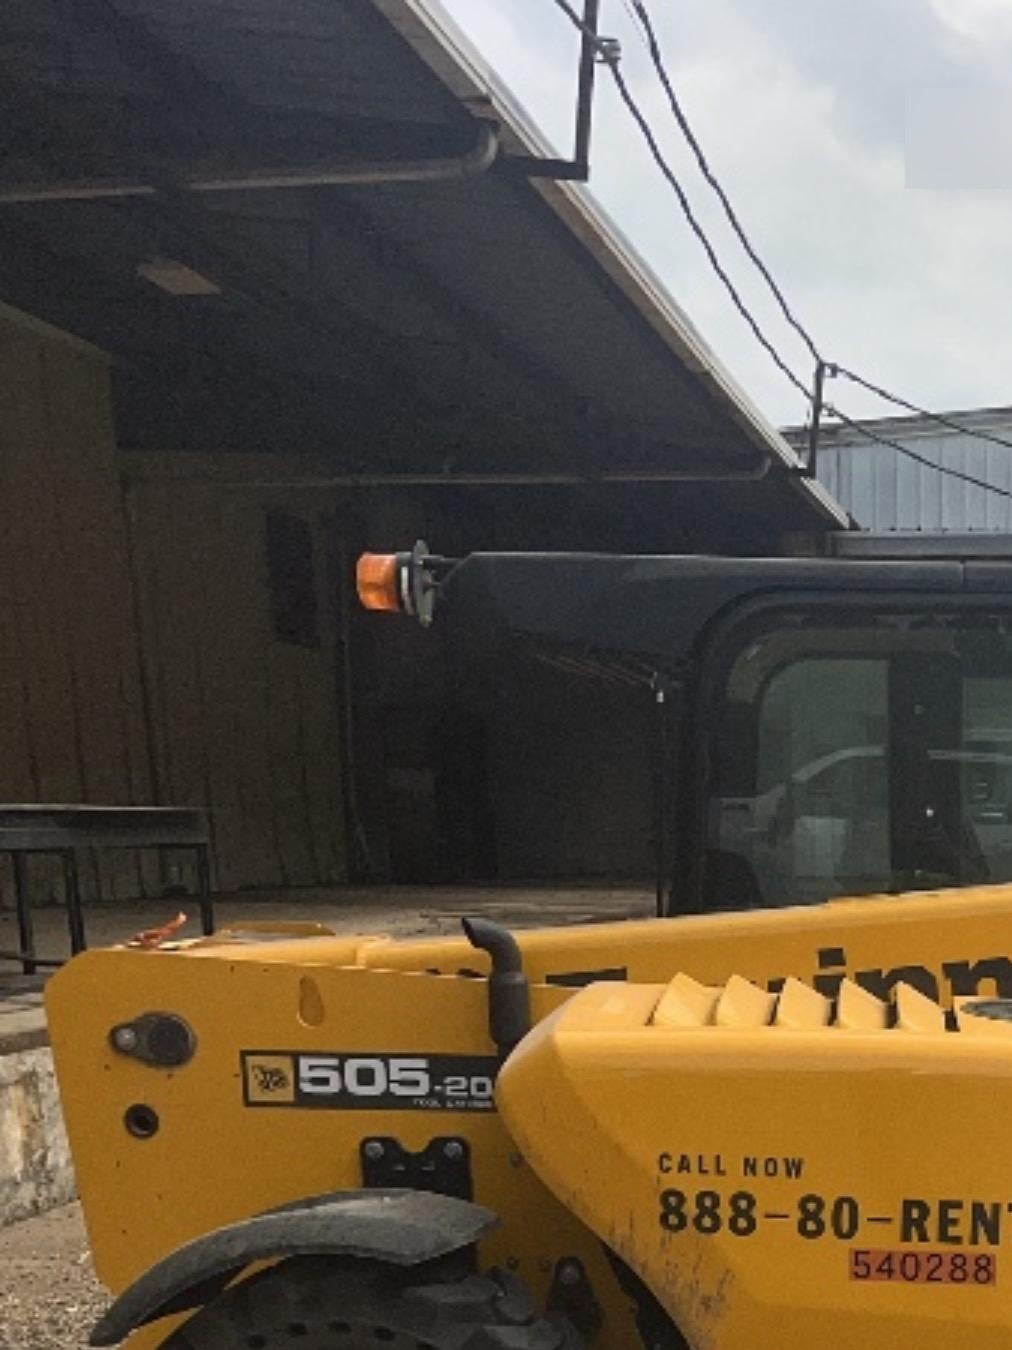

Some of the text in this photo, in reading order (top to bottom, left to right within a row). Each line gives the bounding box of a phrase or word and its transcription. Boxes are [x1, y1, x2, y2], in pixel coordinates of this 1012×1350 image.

[658, 1152, 804, 1179] CALL NOW
[852, 1250, 993, 1285] 540288
